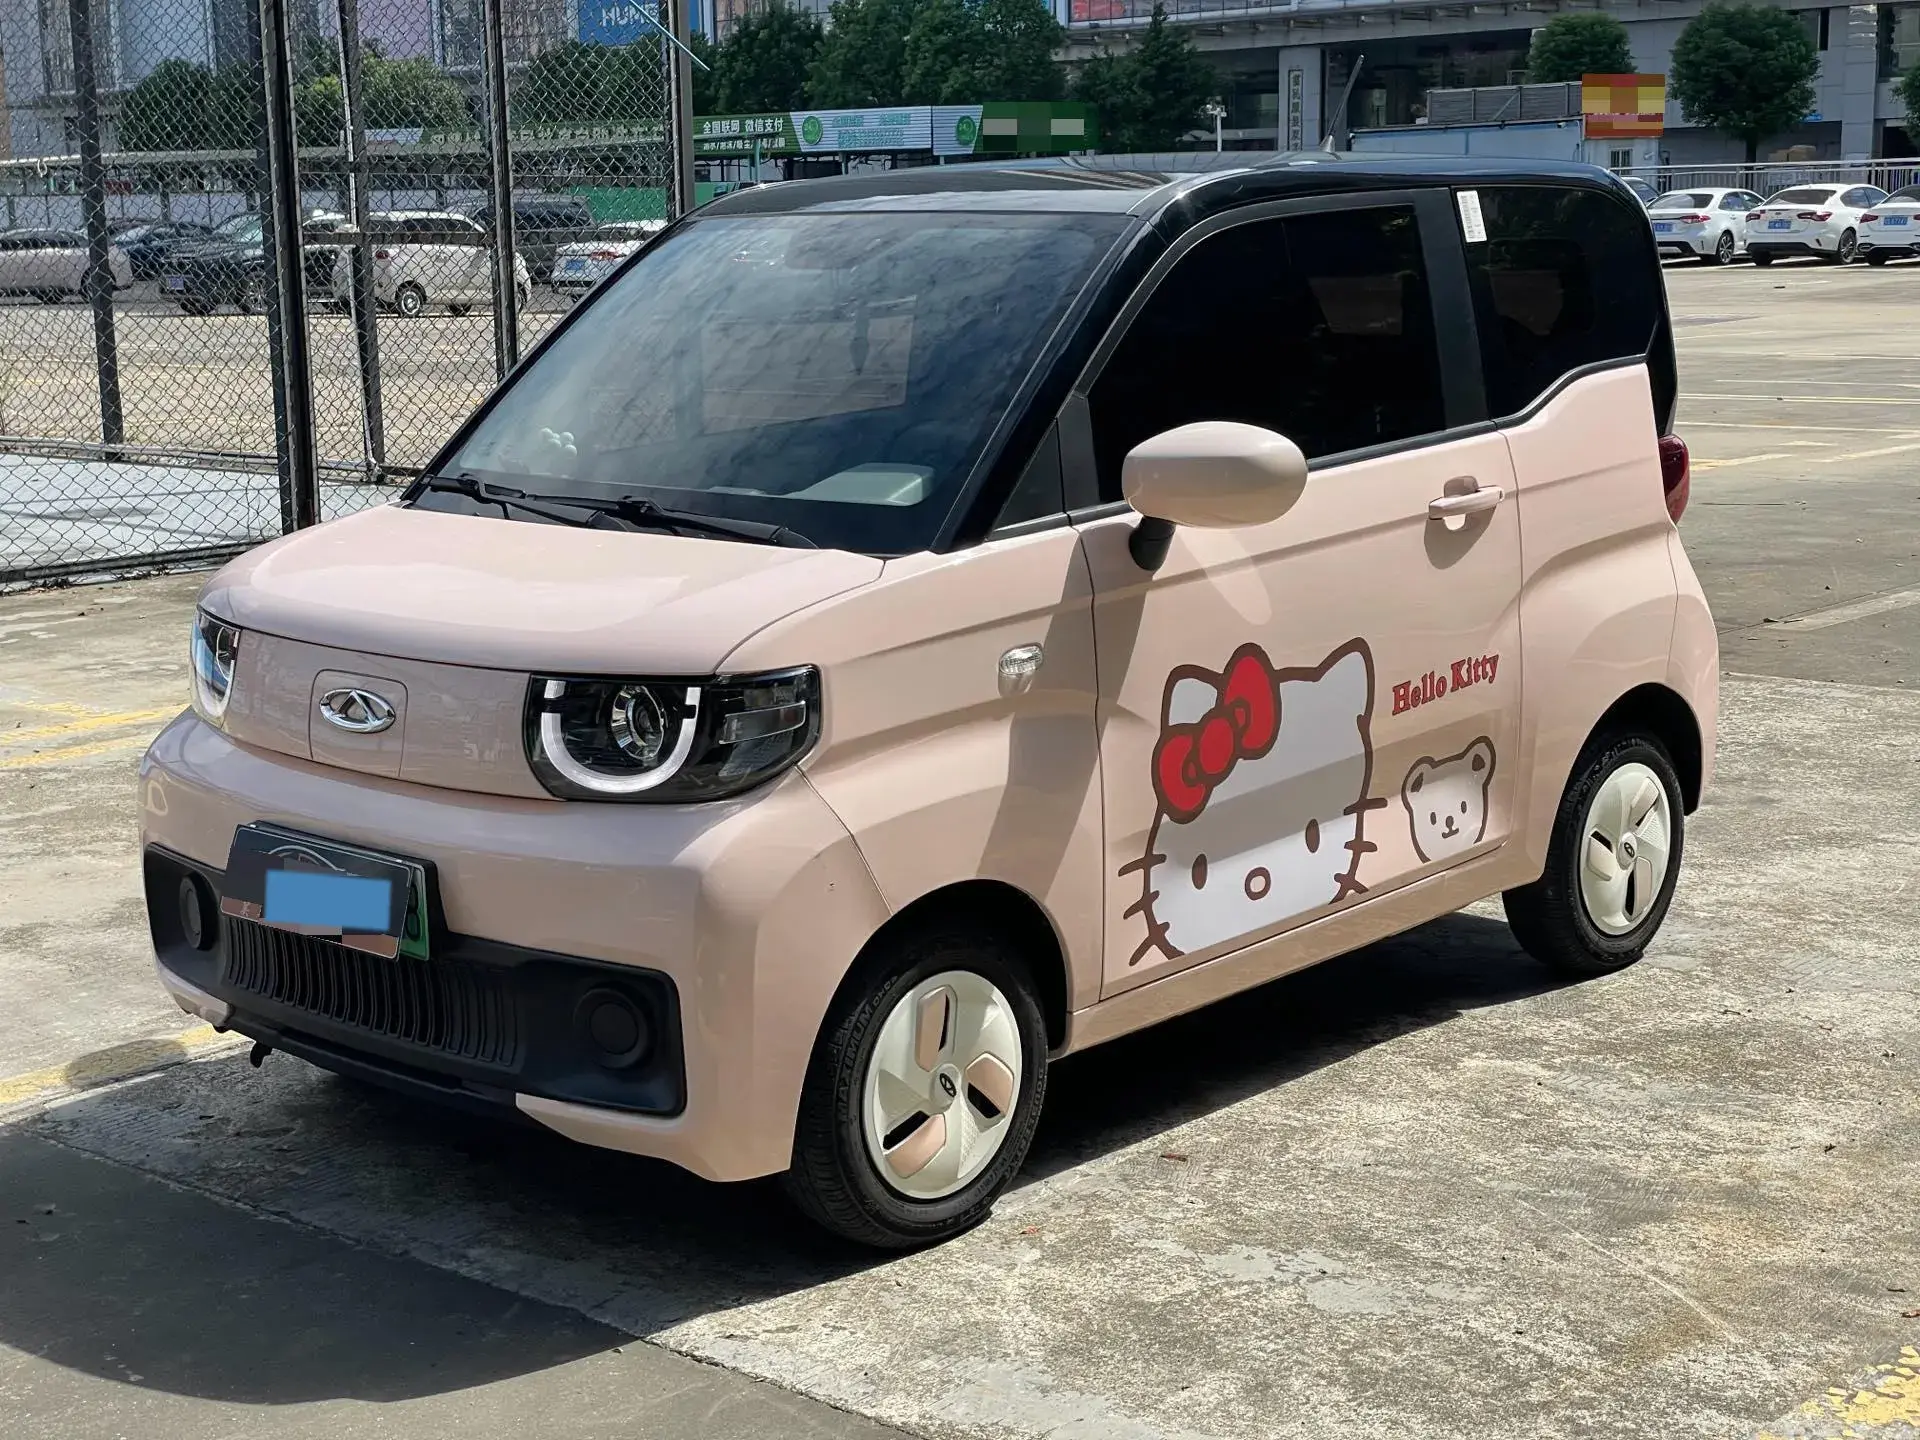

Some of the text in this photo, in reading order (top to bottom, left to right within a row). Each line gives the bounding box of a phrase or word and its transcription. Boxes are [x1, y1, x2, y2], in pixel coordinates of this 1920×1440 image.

[703, 118, 784, 134] 全国联网 微信支付
[1392, 654, 1499, 716] Hello Kitty
[836, 1003, 874, 1123] MAXIMUM
